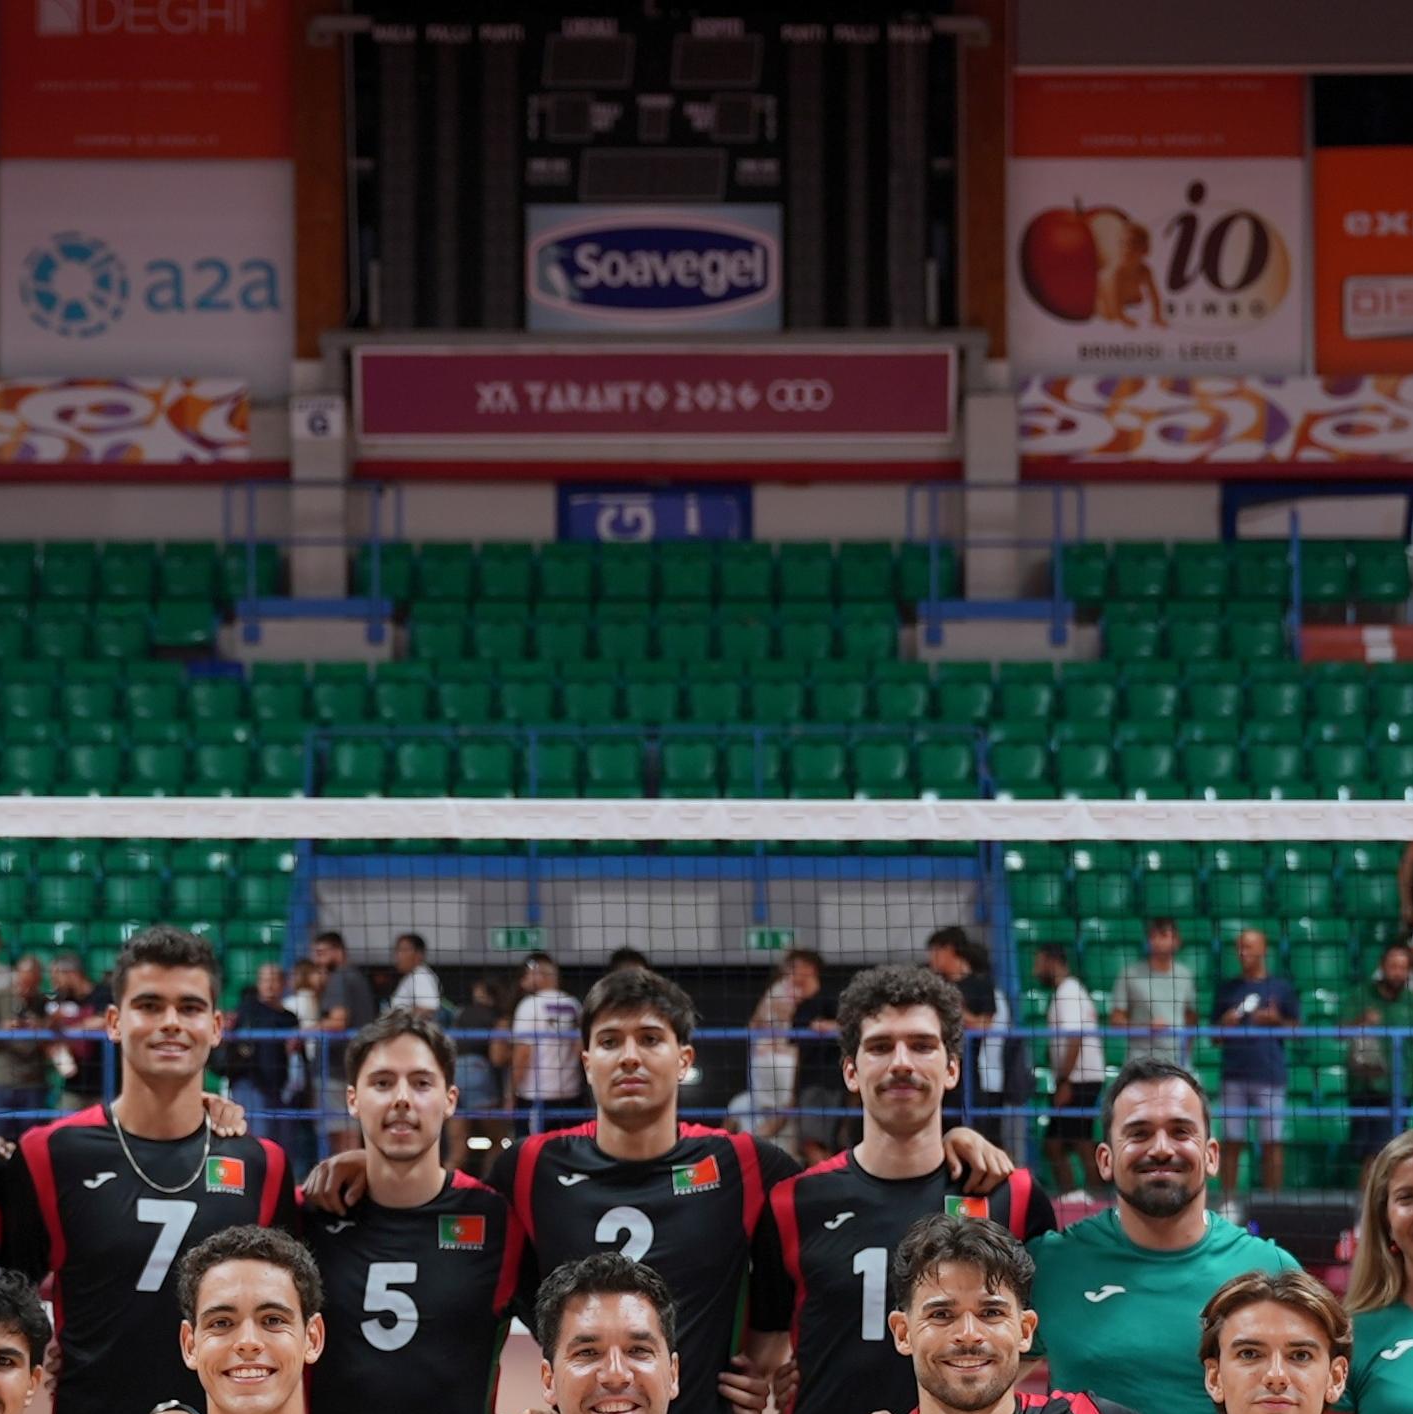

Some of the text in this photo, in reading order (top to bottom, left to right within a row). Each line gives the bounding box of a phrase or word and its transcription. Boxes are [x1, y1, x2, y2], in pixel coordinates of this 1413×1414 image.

[88, 0, 246, 35] DEGHI
[1164, 178, 1270, 293] io
[145, 256, 281, 314] a2a
[573, 243, 765, 298] Soavegel
[524, 379, 668, 413] TARANTO
[136, 1198, 198, 1292] 7
[594, 1205, 654, 1263] 2
[360, 1261, 420, 1352] 5
